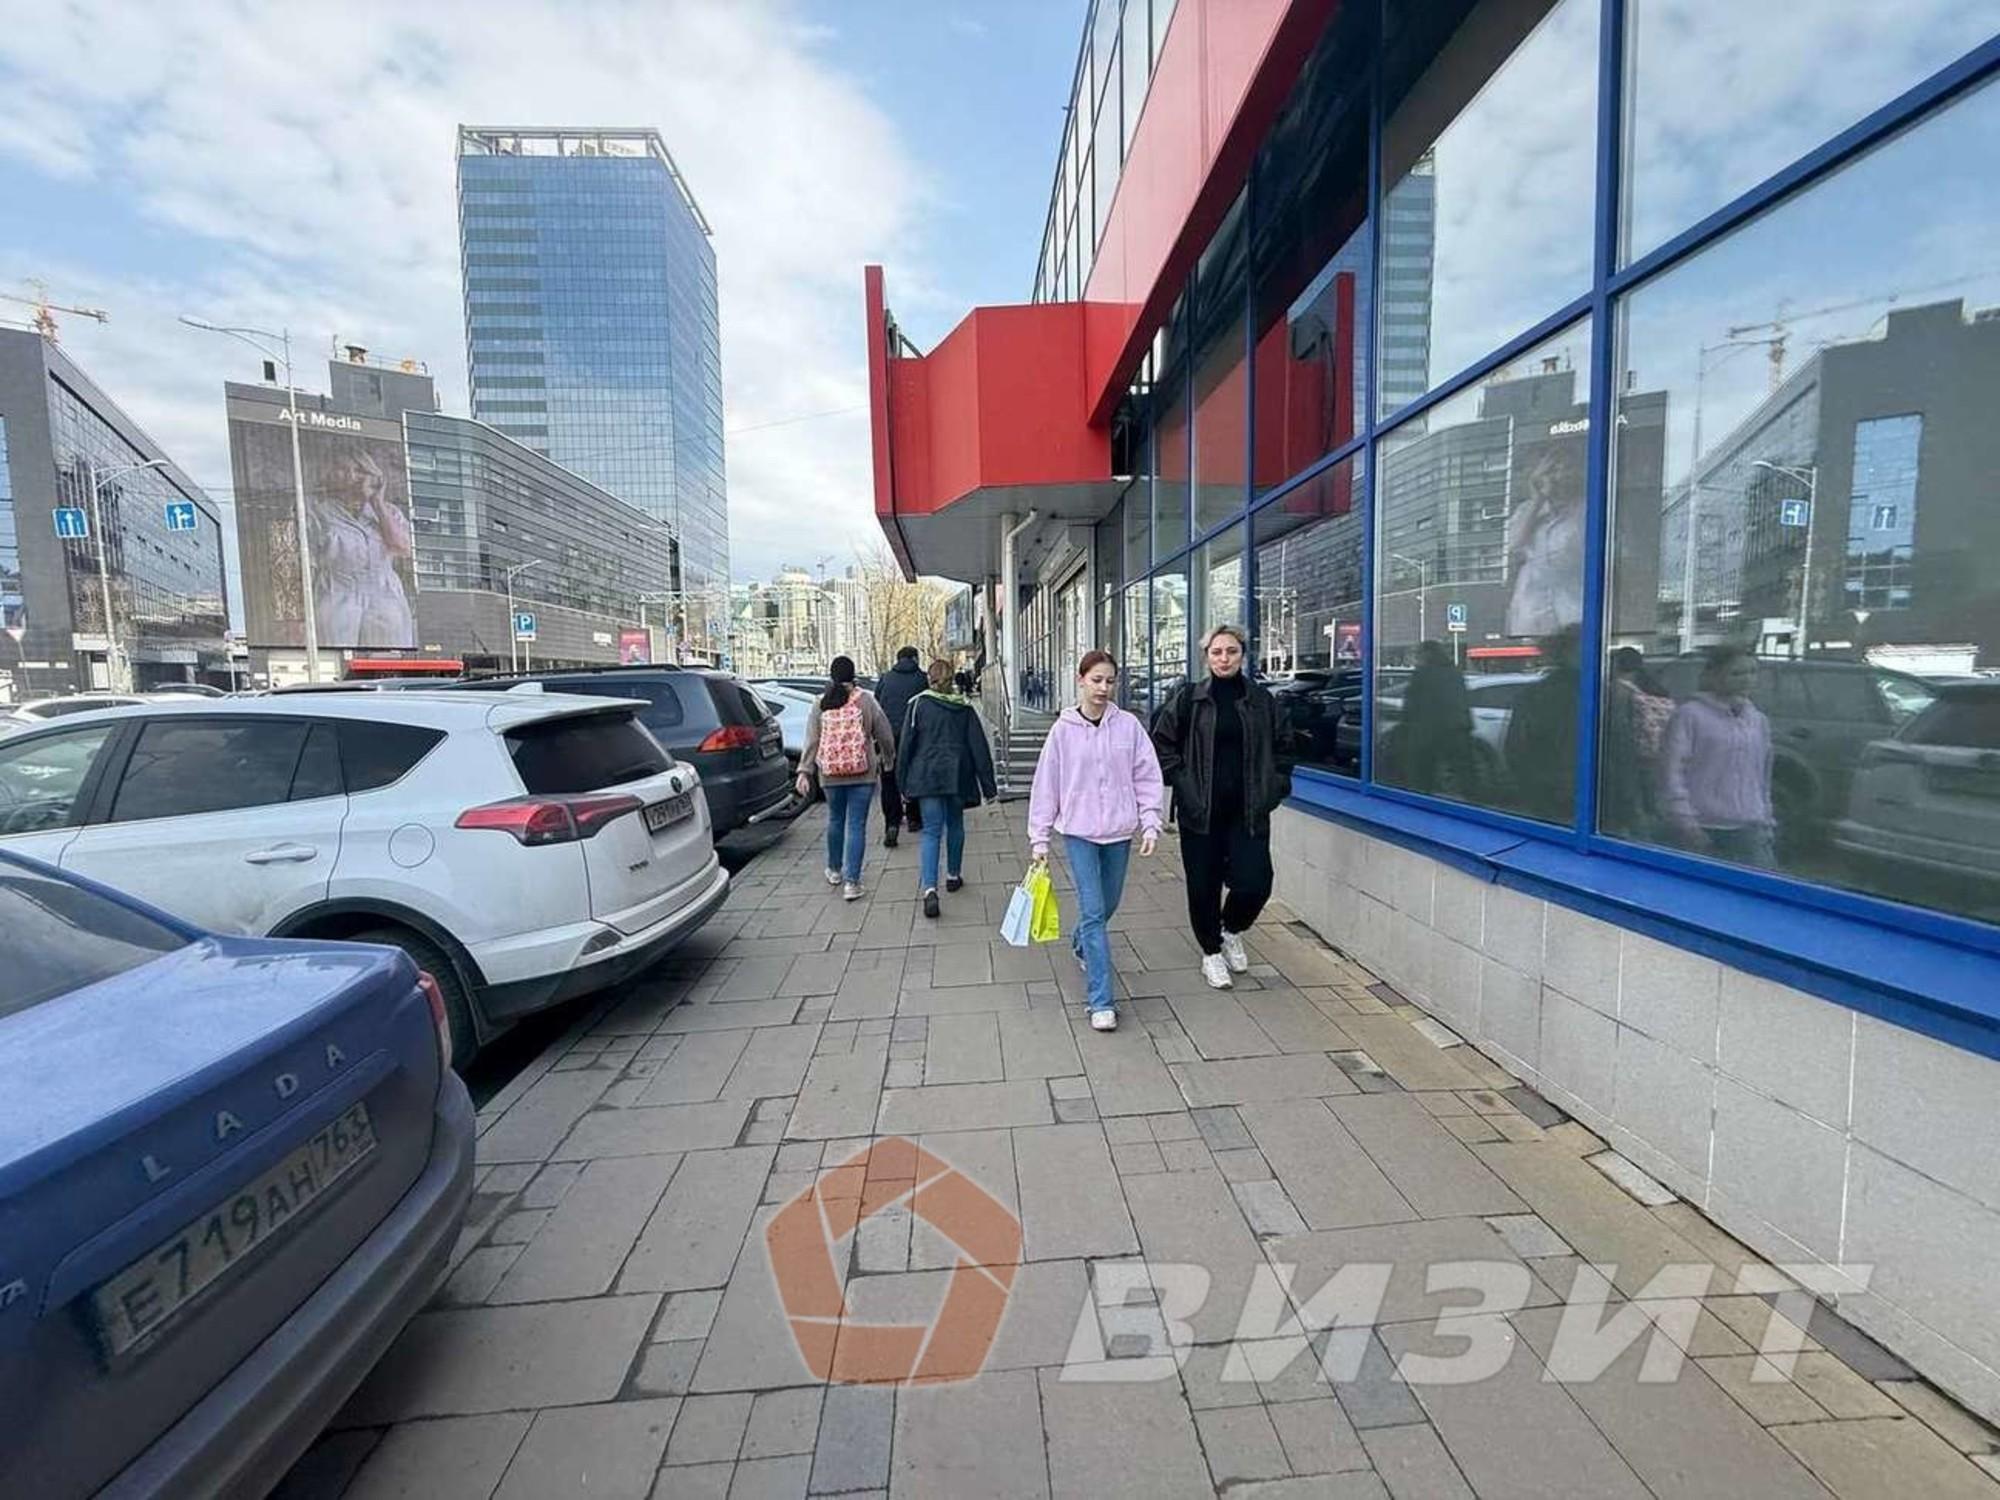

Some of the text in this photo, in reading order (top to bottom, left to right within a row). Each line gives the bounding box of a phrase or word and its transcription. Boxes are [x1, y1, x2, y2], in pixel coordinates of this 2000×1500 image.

[278, 408, 361, 430] Art Media
[520, 615, 531, 630] P
[142, 1043, 345, 1183] LADA
